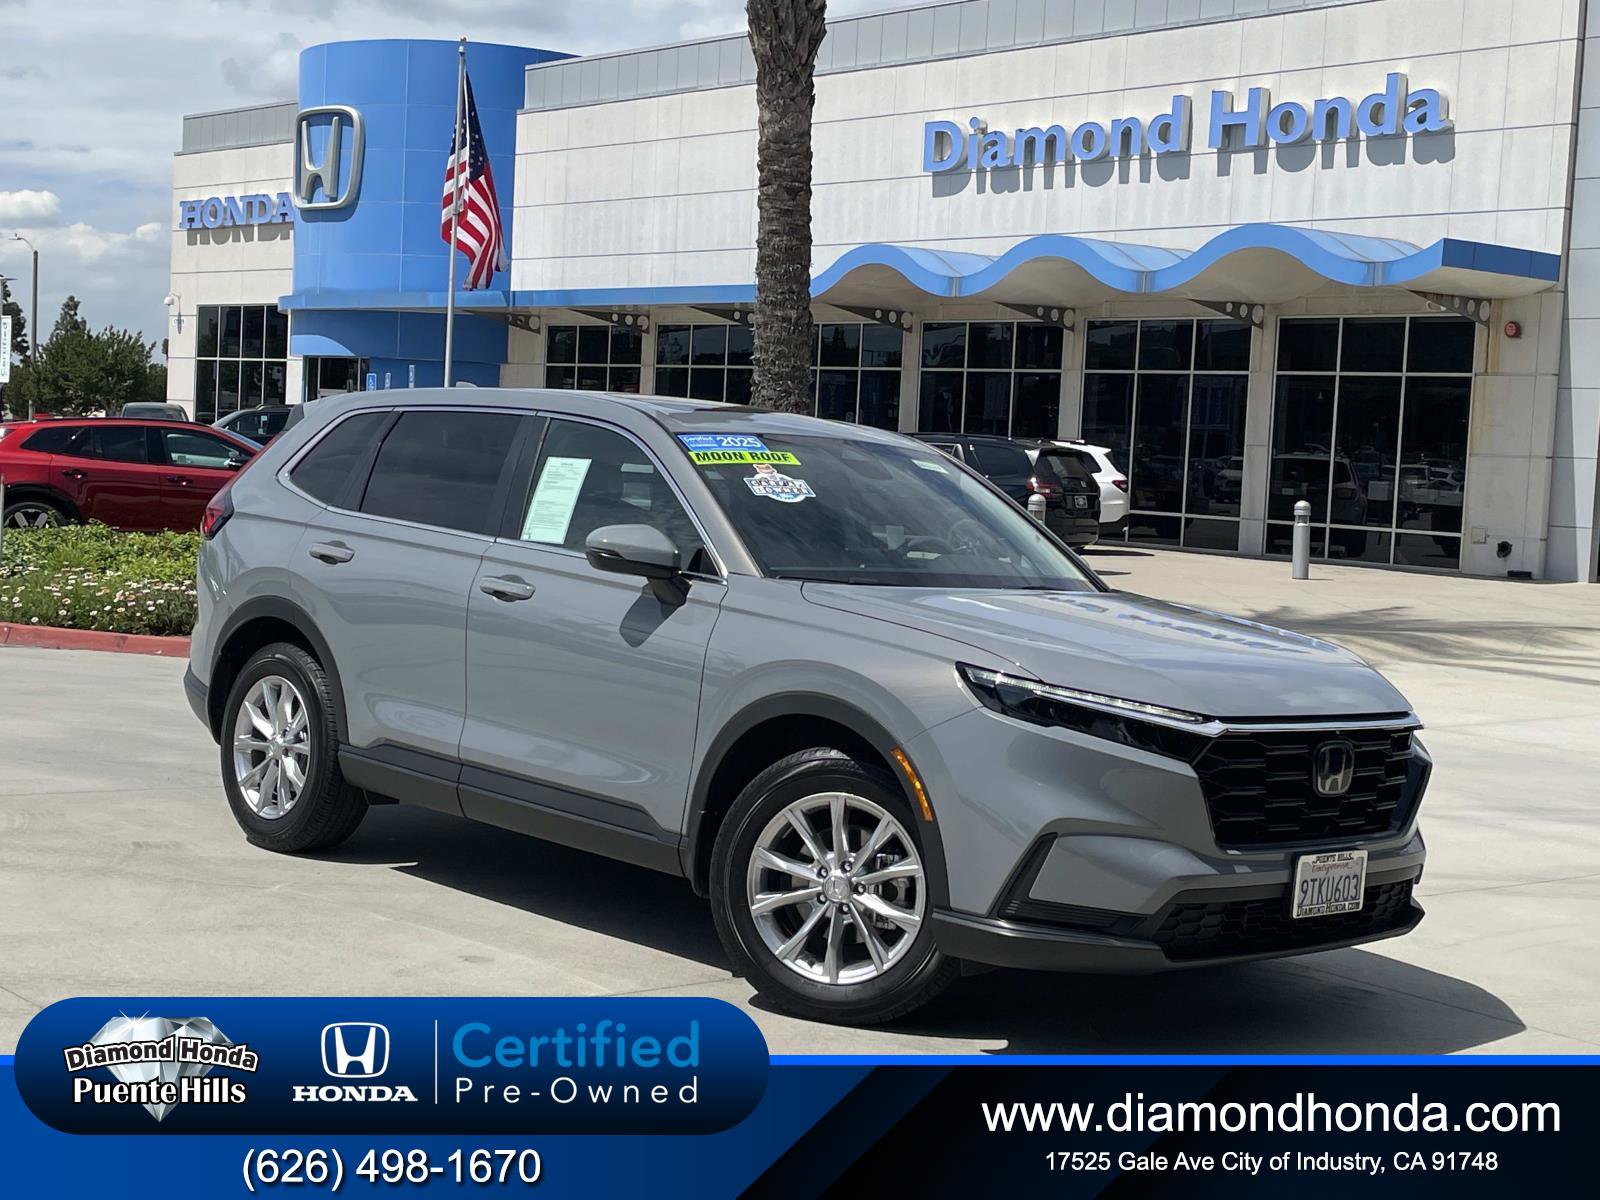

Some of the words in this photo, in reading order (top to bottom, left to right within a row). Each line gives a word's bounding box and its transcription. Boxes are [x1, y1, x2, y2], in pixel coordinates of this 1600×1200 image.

[923, 95, 1191, 173] Diamond
[1208, 72, 1453, 148] Honda
[179, 192, 296, 229] HONDA
[696, 451, 744, 462] MOON
[751, 452, 791, 463] ROOF
[717, 436, 761, 448] 2025
[1301, 874, 1360, 906] 9TKU603
